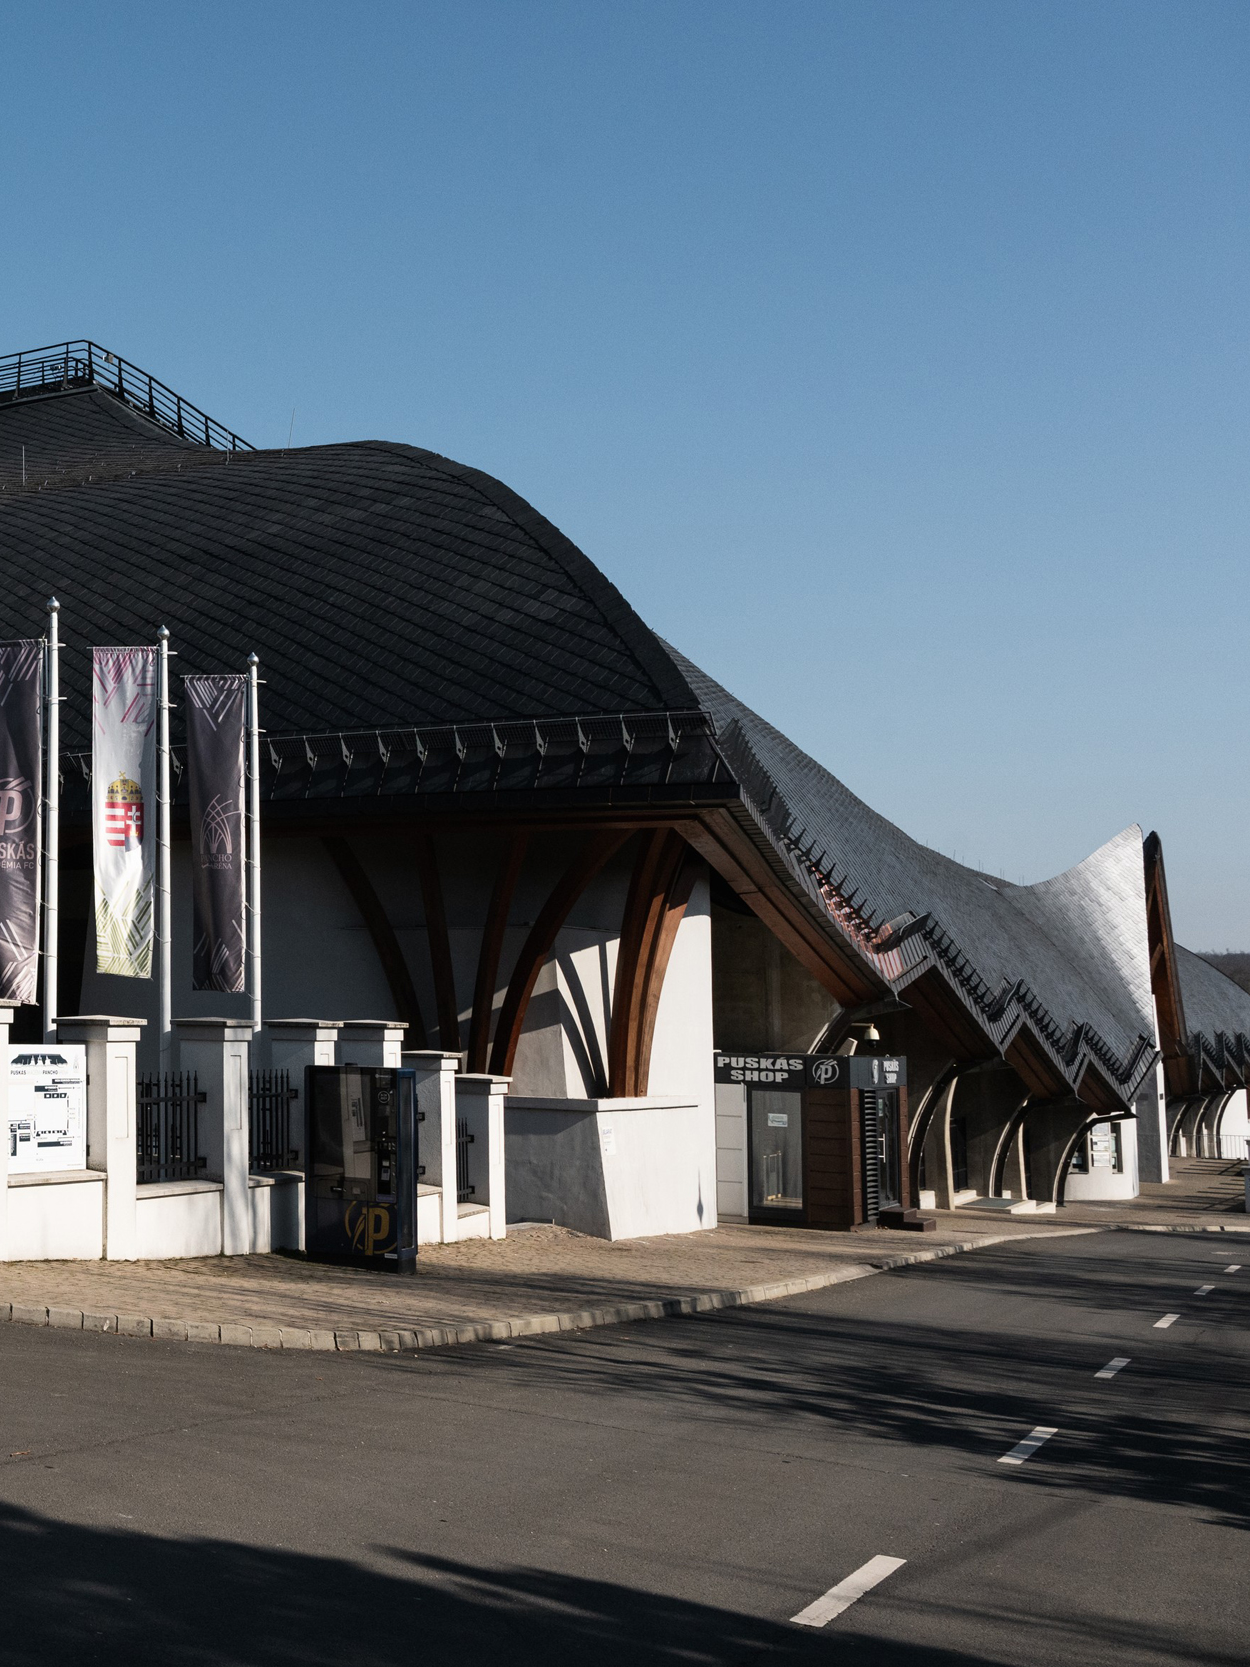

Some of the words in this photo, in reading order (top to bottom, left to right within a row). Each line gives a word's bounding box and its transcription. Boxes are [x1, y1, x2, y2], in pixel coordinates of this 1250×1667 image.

[200, 852, 233, 863] PANCHO
[23, 861, 35, 870] FC
[717, 1056, 804, 1071] PUSKÁS
[730, 1070, 790, 1083] SHOP
